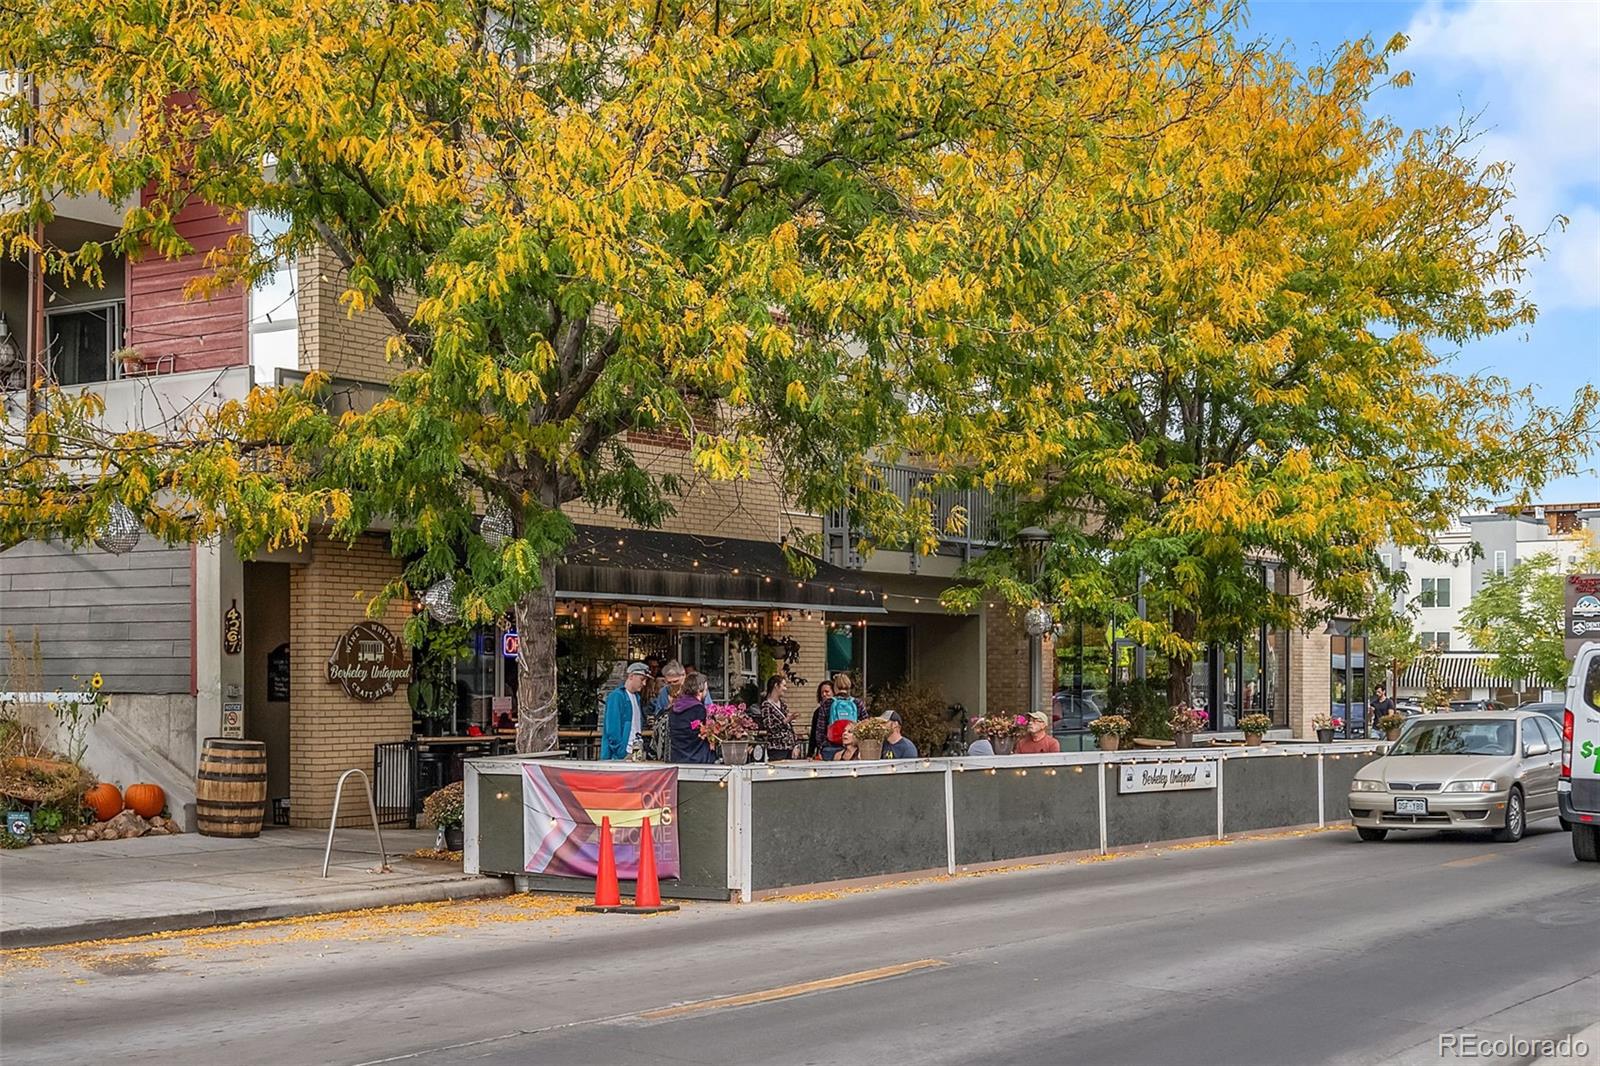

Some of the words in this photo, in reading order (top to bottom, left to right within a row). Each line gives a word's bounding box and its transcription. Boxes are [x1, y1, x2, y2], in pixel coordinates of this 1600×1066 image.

[226, 608, 240, 653] 4267
[345, 630, 360, 653] WINE
[506, 636, 519, 653] OP
[330, 663, 368, 682] Berkeley
[370, 663, 412, 681] Untapped
[351, 682, 374, 698] CRAFT
[1142, 767, 1168, 788] Berkeley
[1169, 766, 1198, 787] Untapped
